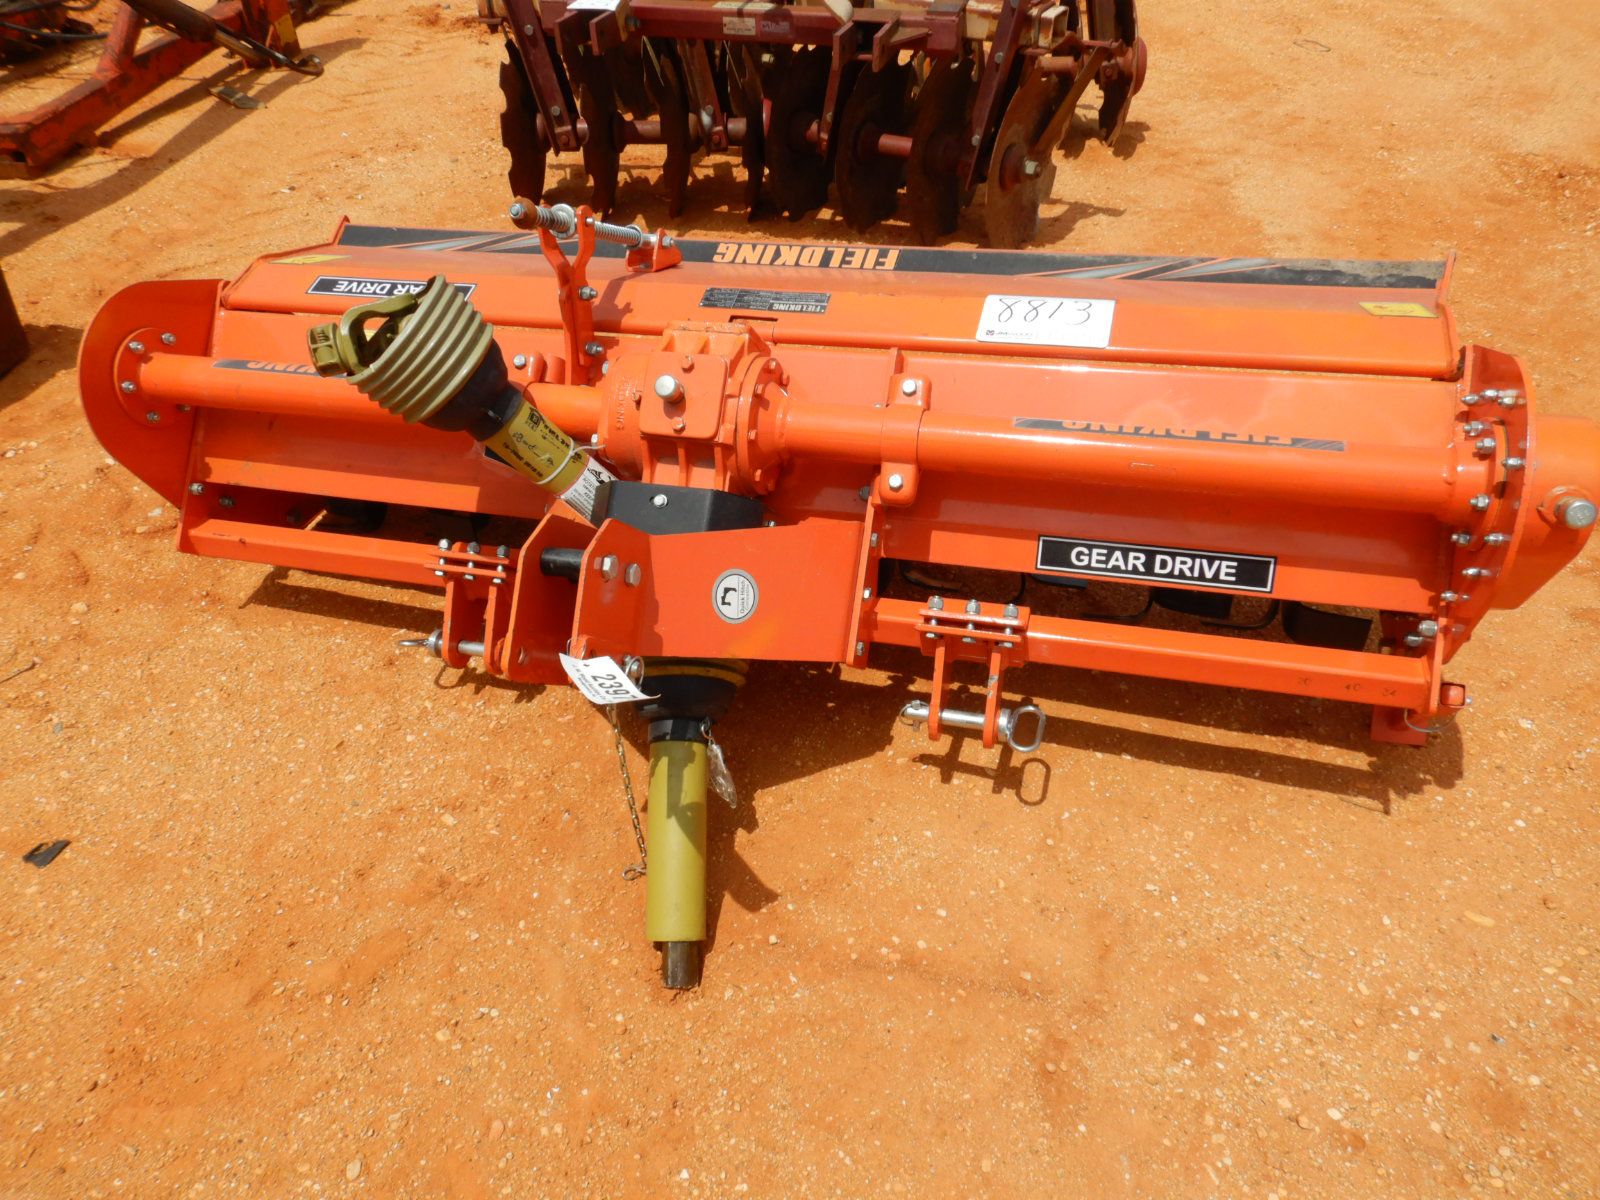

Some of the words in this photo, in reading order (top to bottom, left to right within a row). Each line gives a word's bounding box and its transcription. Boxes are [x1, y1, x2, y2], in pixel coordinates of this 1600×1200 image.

[713, 242, 900, 270] FIELDKING
[333, 280, 391, 294] DRIVE
[772, 303, 821, 312] FIELDKING
[998, 298, 1093, 326] 8813
[1070, 546, 1146, 572] GEAR
[1154, 554, 1238, 581] DRIVE
